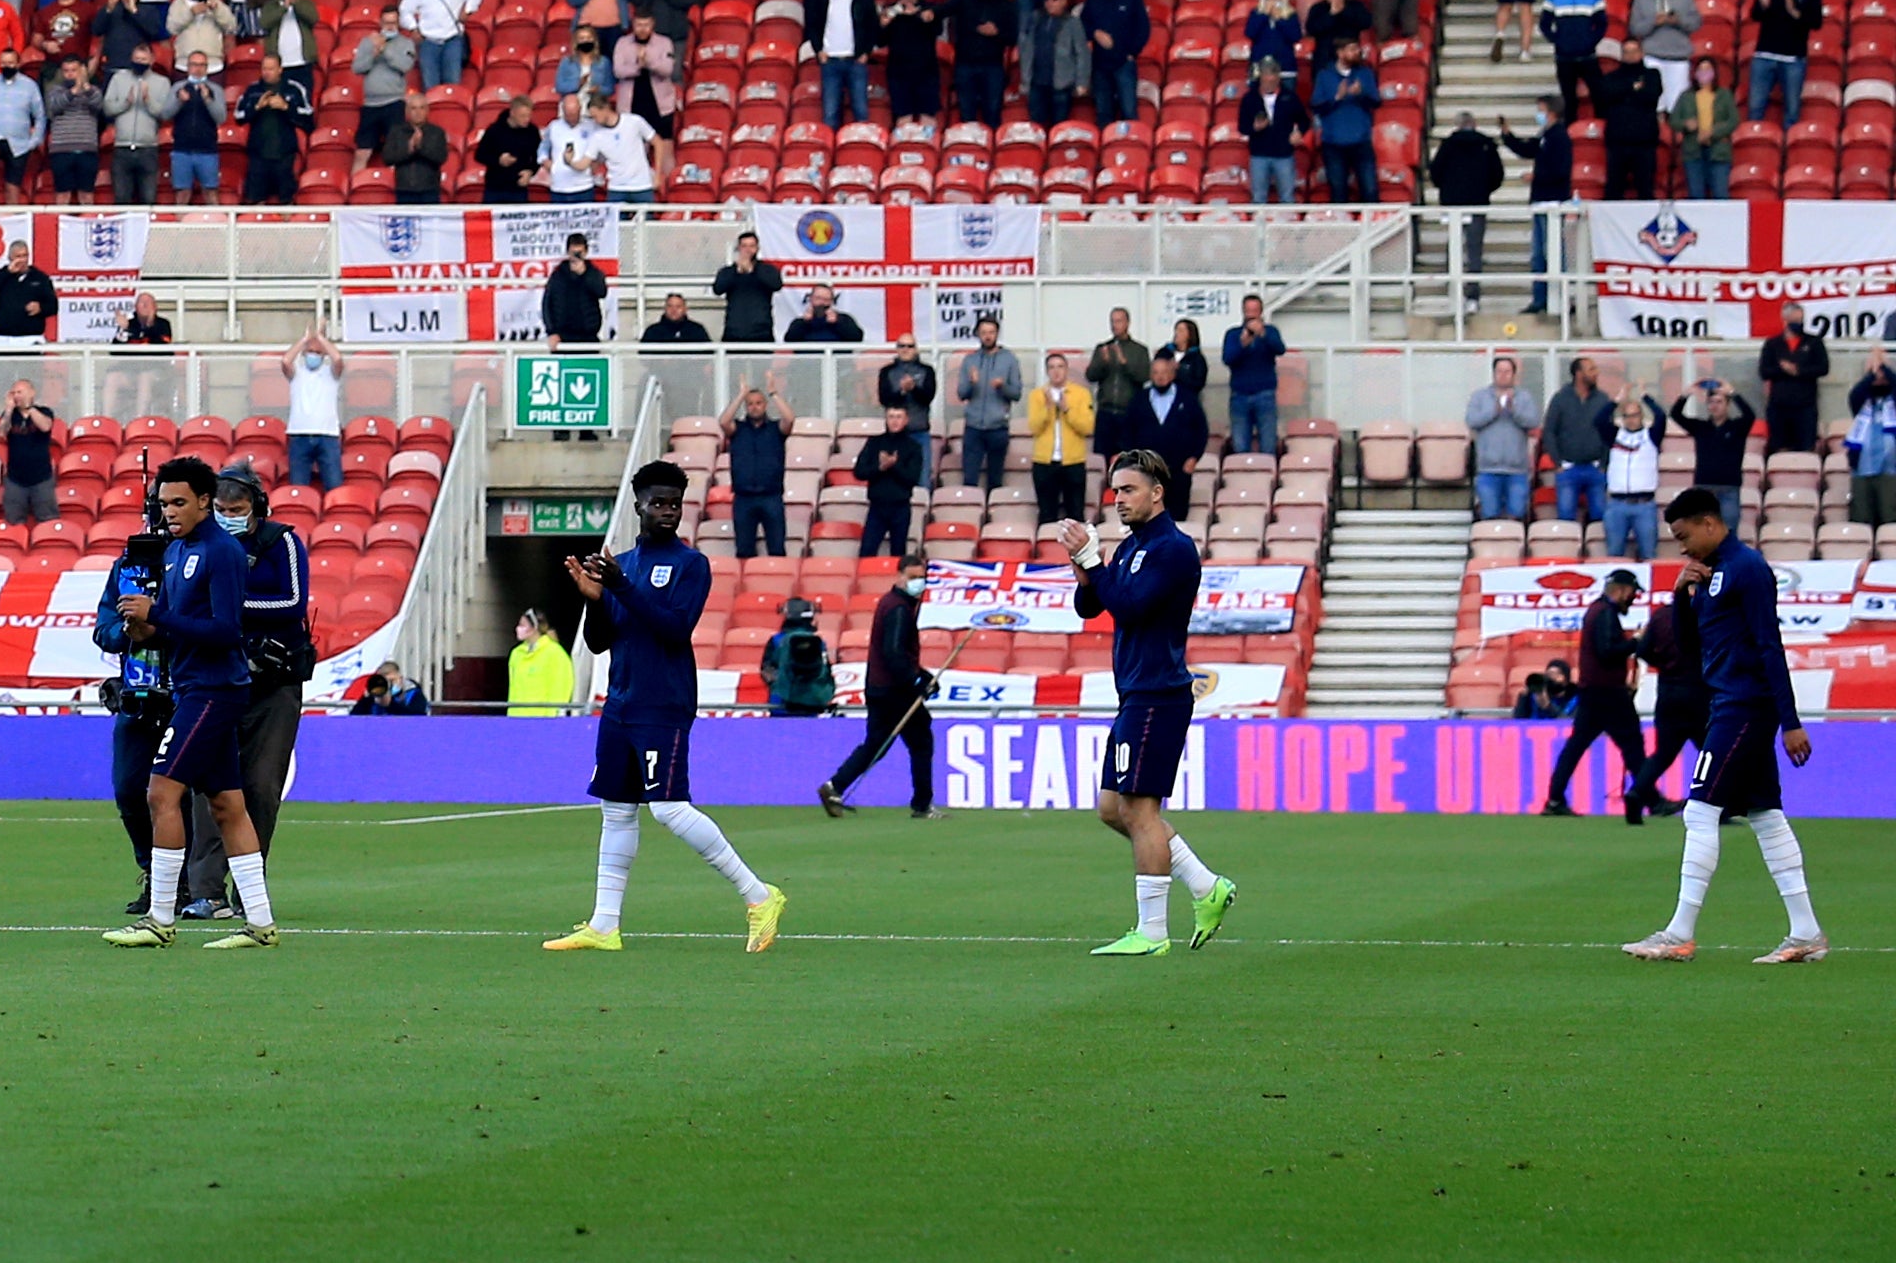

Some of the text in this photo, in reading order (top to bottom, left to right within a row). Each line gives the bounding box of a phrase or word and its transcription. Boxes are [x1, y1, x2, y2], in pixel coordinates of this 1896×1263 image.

[506, 222, 540, 232] STOP
[510, 233, 554, 244] ABOUT
[512, 244, 562, 256] BETTER
[780, 262, 932, 279] CUNTHORPE
[1605, 264, 1720, 299] ERNIE
[969, 289, 1002, 305] SIN
[68, 301, 104, 314] DAVE
[369, 310, 441, 333] L.J.M
[940, 309, 967, 323] UP
[528, 409, 597, 424] FIRE EXIT
[535, 503, 561, 516] Fire
[536, 517, 560, 529] exit
[157, 726, 175, 756] 2
[645, 750, 659, 780] 7
[1114, 742, 1131, 773] 10
[946, 724, 1205, 810] SEARH
[1237, 724, 1409, 813] HOPE
[1692, 750, 1713, 784] 11
